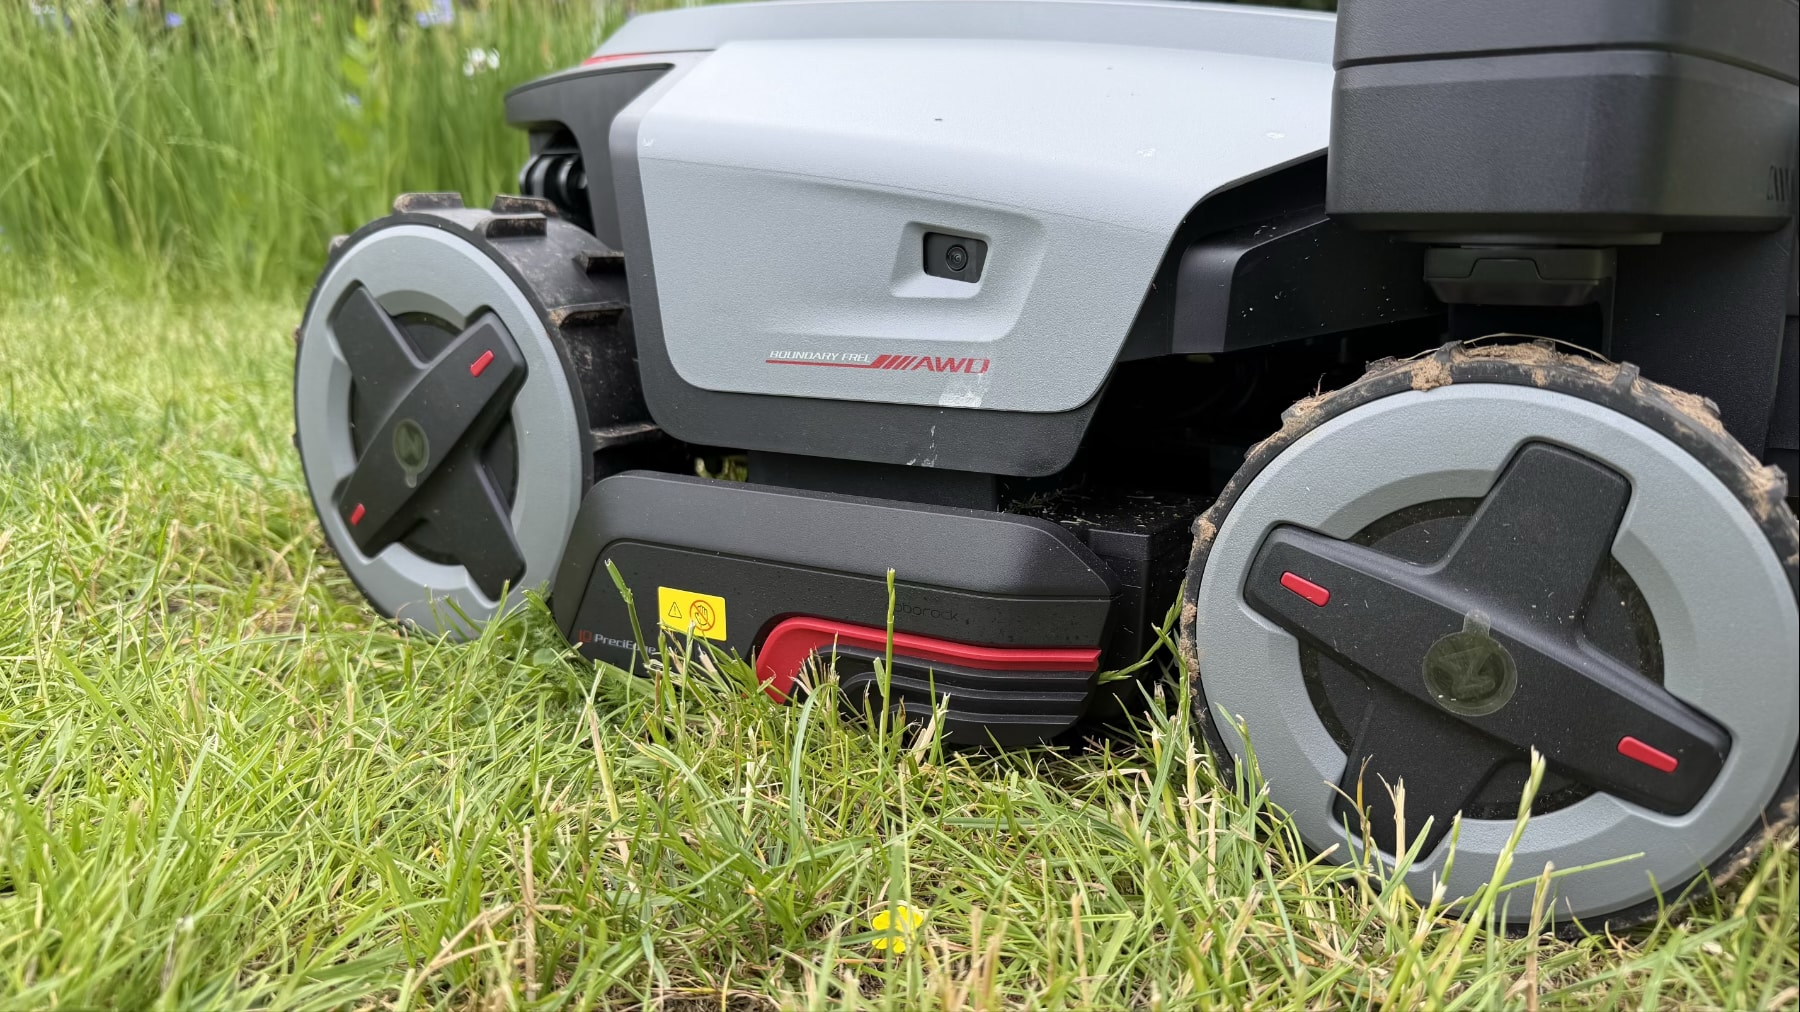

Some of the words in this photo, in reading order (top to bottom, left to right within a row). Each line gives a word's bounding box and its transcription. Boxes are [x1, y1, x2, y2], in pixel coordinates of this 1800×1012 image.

[769, 350, 840, 361] BOUNDARY
[910, 355, 990, 374] AWD
[887, 602, 959, 622] oborock
[594, 633, 657, 654] PreciEe
